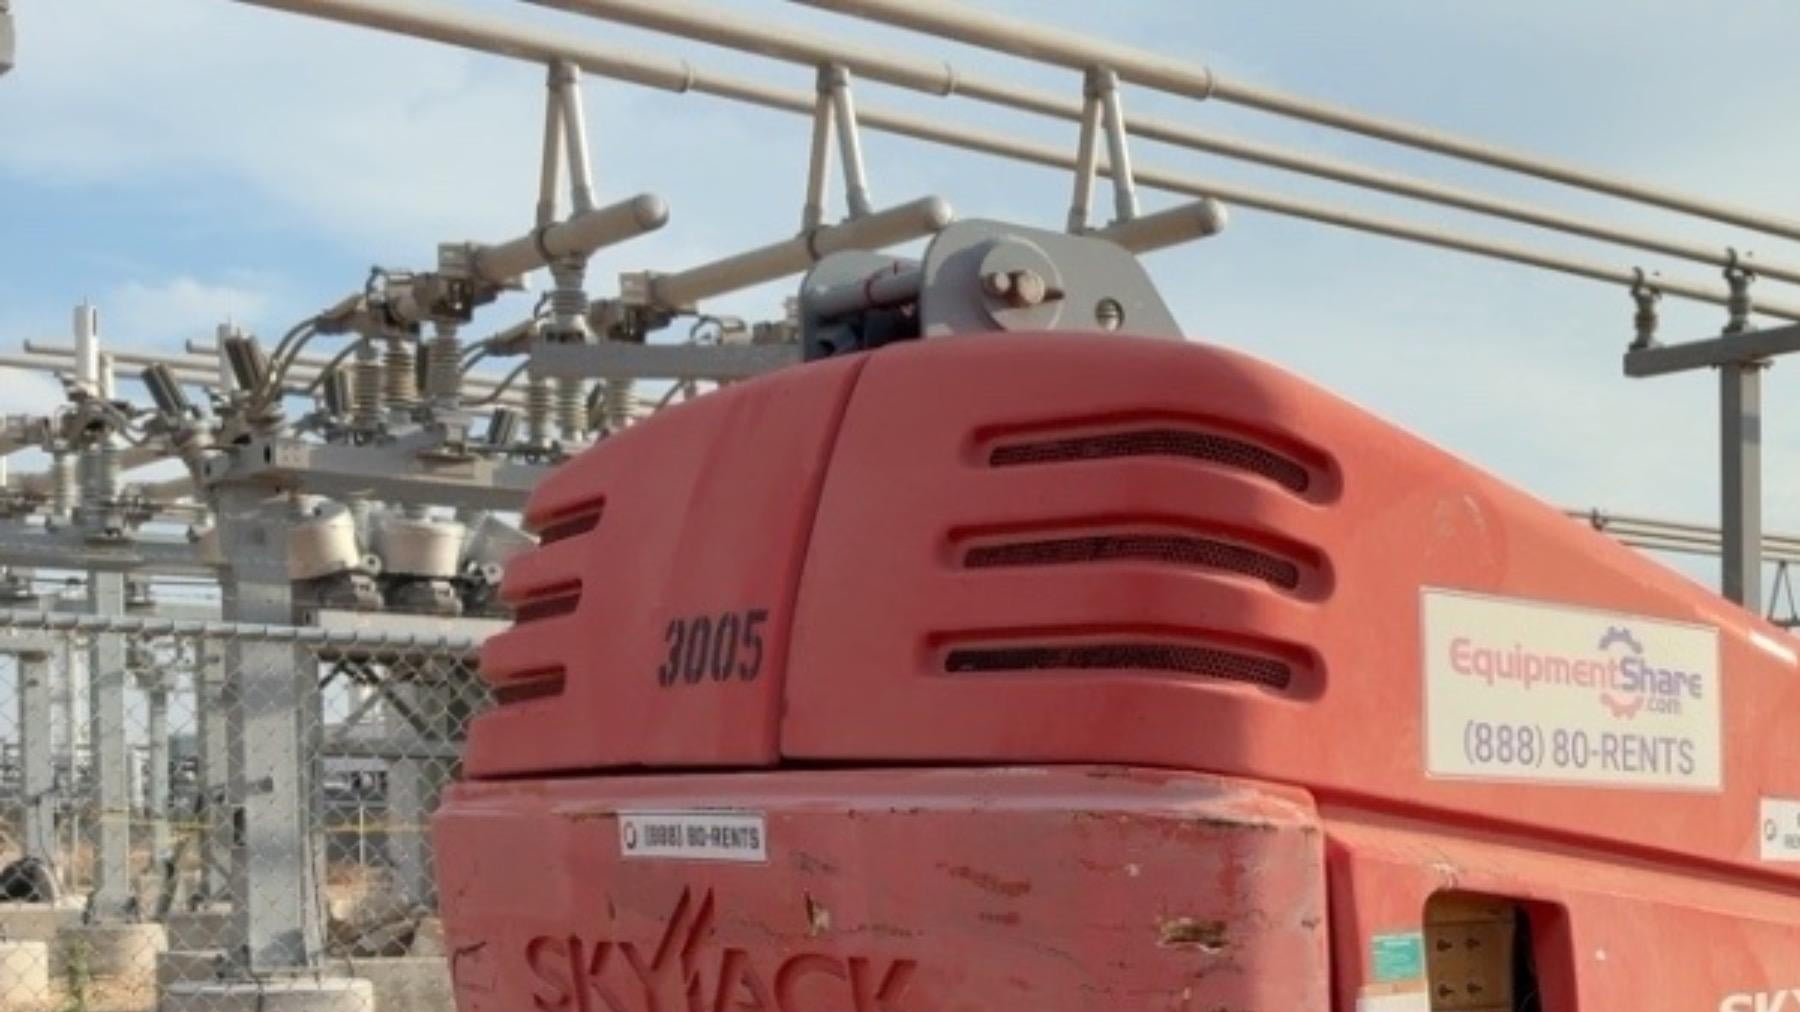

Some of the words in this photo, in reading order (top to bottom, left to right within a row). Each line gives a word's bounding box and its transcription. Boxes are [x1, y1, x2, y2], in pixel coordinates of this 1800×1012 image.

[657, 609, 769, 688] 3005
[1449, 636, 1703, 698] EquipmentShare
[1646, 697, 1682, 715] .com
[1463, 719, 1545, 768] (888)
[1552, 727, 1696, 776] 80-RENTS
[686, 825, 760, 850] 80-RENTS
